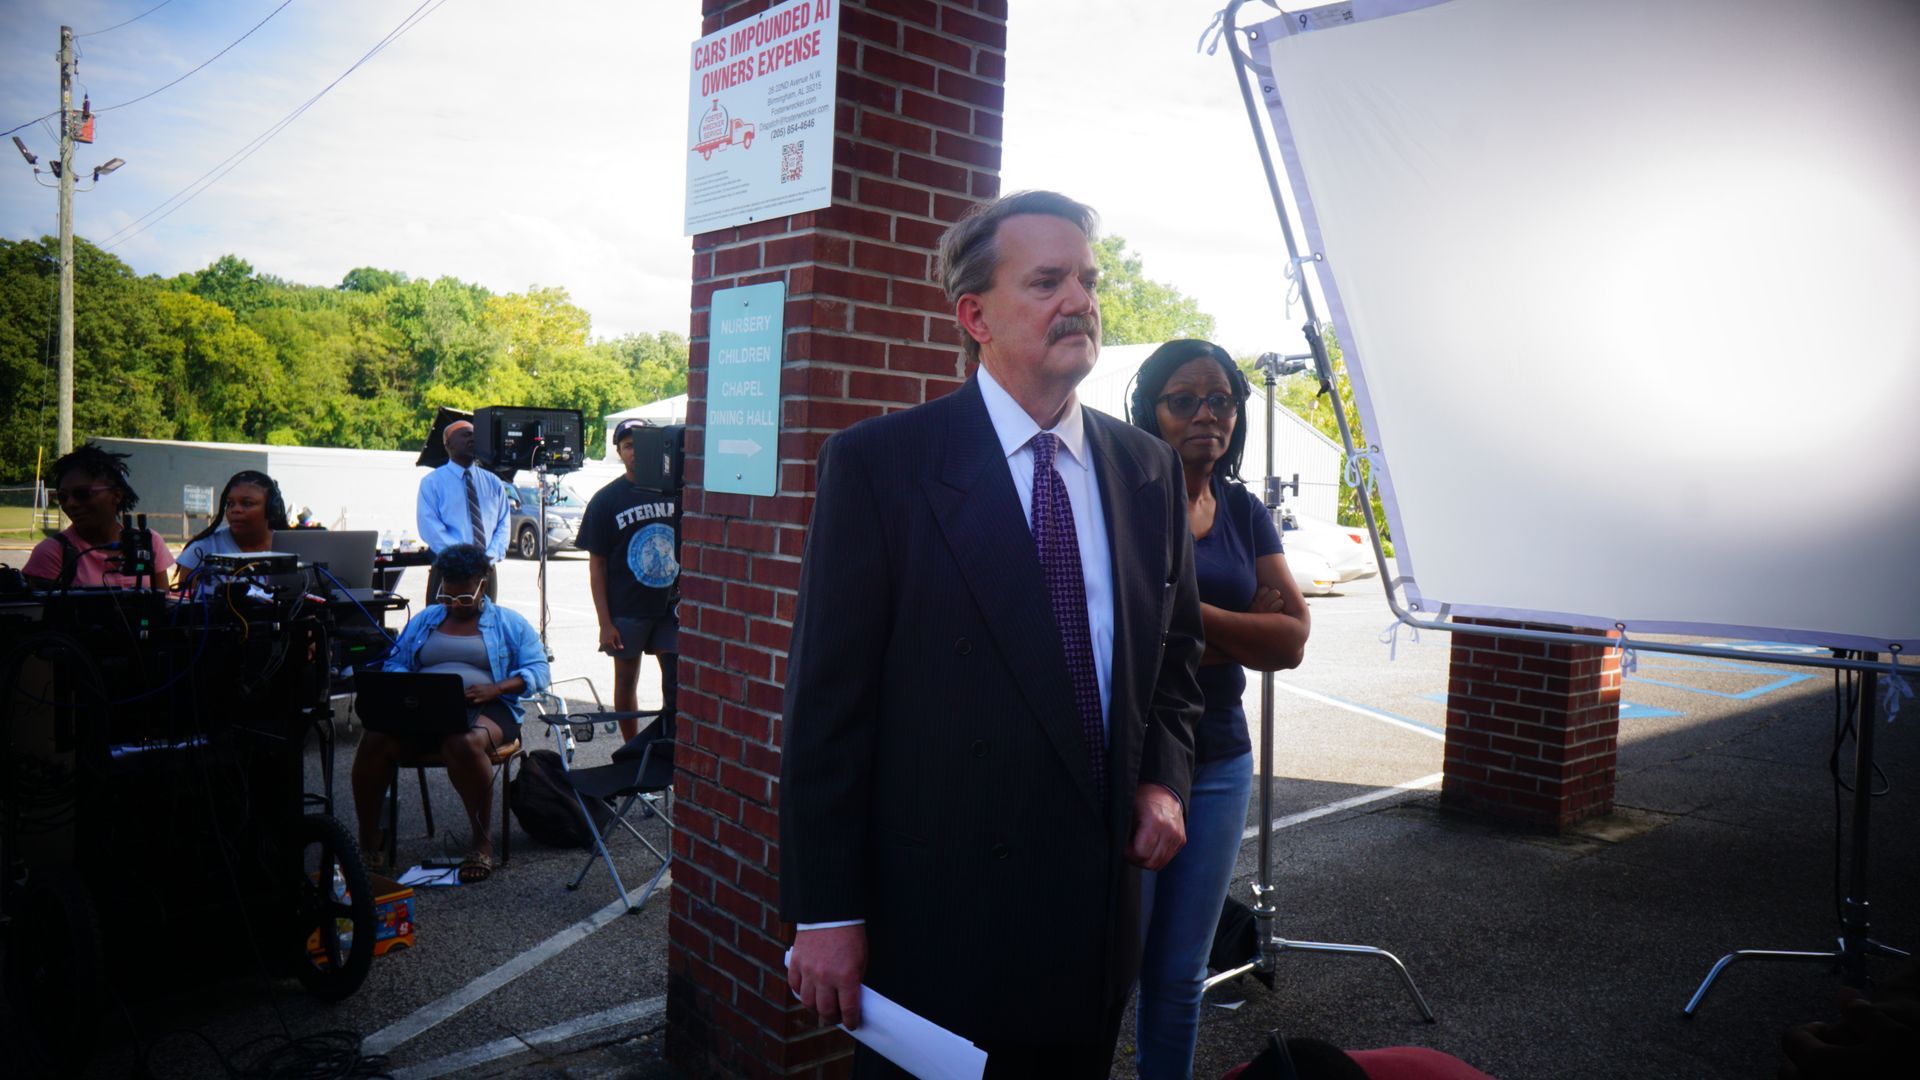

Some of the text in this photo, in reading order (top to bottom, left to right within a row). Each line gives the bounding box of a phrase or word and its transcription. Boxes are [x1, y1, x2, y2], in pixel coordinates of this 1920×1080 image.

[694, 37, 726, 71] CARS
[730, 2, 810, 57] IMPOUNDED
[702, 30, 821, 97] OWNERS EXPENSE
[770, 127, 786, 141] (205)
[720, 315, 772, 335] NURSERY
[718, 347, 771, 365] CHILDREN
[722, 381, 763, 397] CHAPEL
[710, 410, 775, 426] DINING HALL
